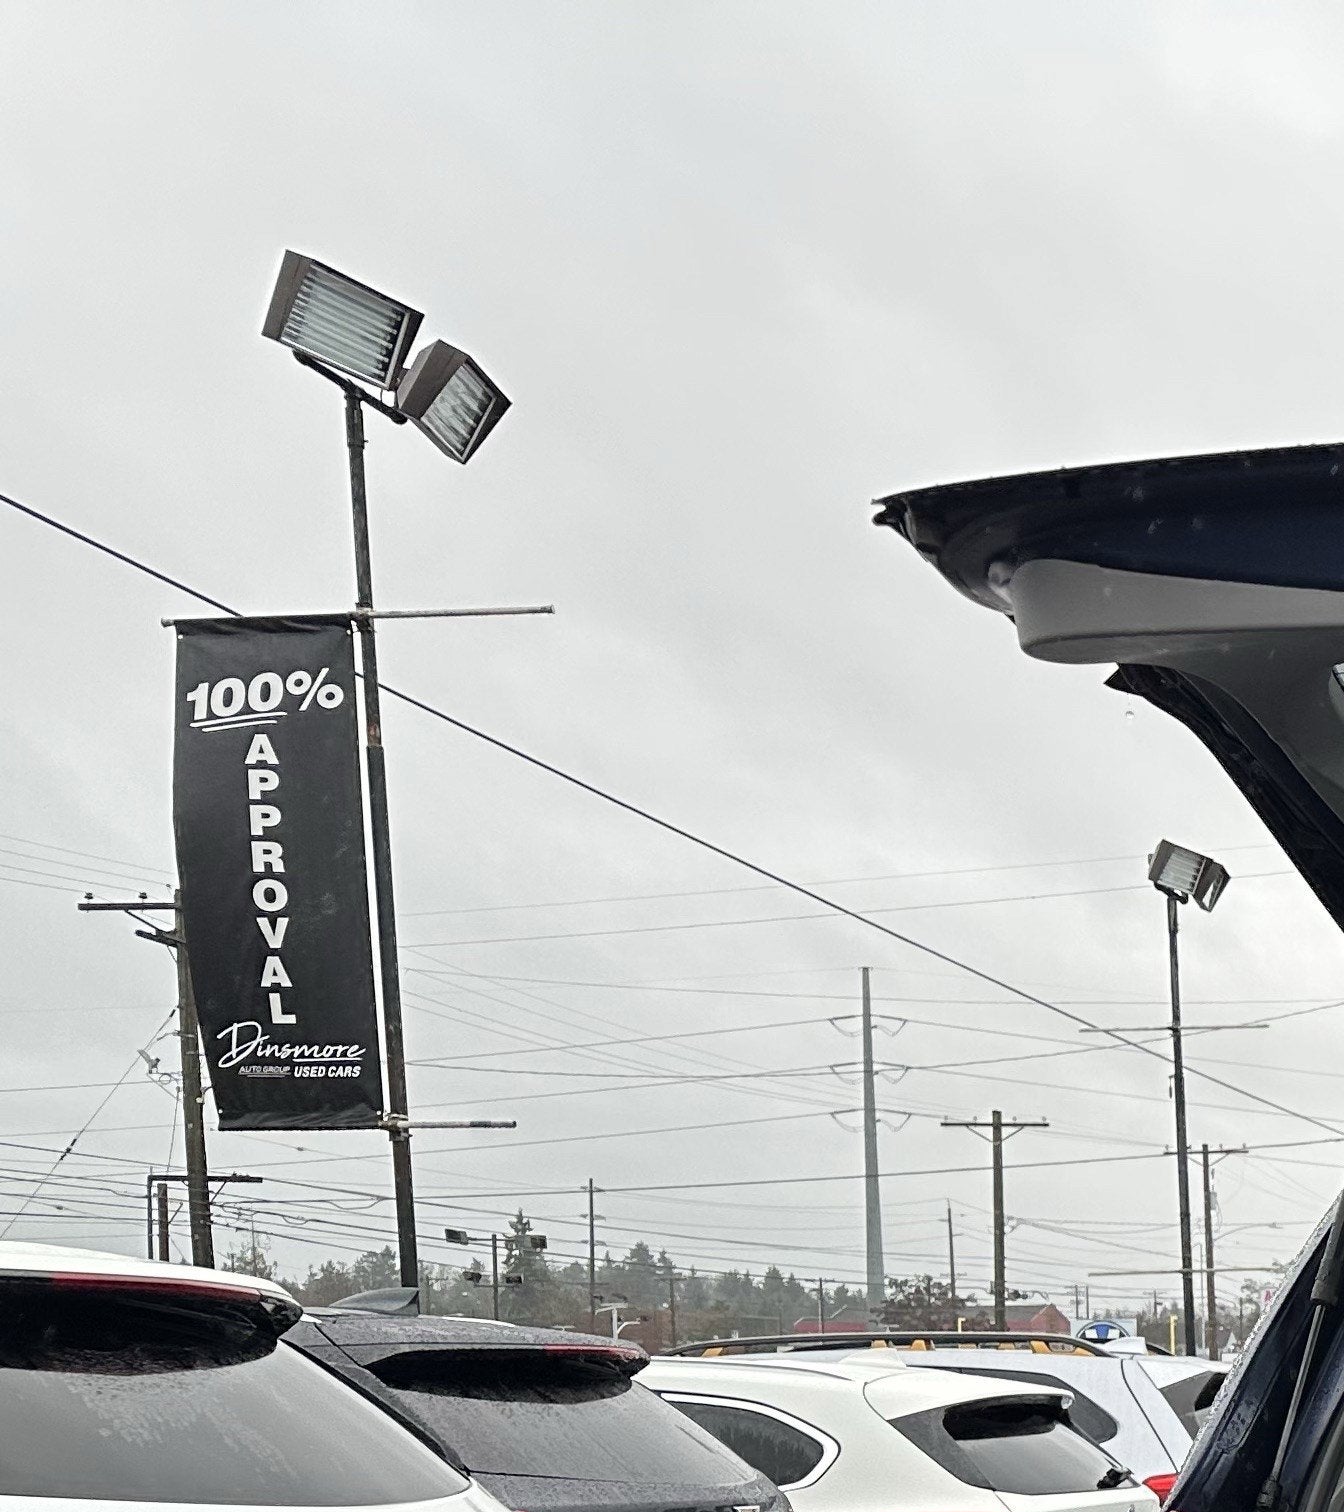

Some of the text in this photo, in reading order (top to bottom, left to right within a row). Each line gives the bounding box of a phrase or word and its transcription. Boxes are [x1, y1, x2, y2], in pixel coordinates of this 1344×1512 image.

[186, 667, 344, 721] 100%
[244, 733, 296, 1026] APPROVAL
[216, 1021, 367, 1068] Dinsmore
[294, 1065, 361, 1078] USED CARS
